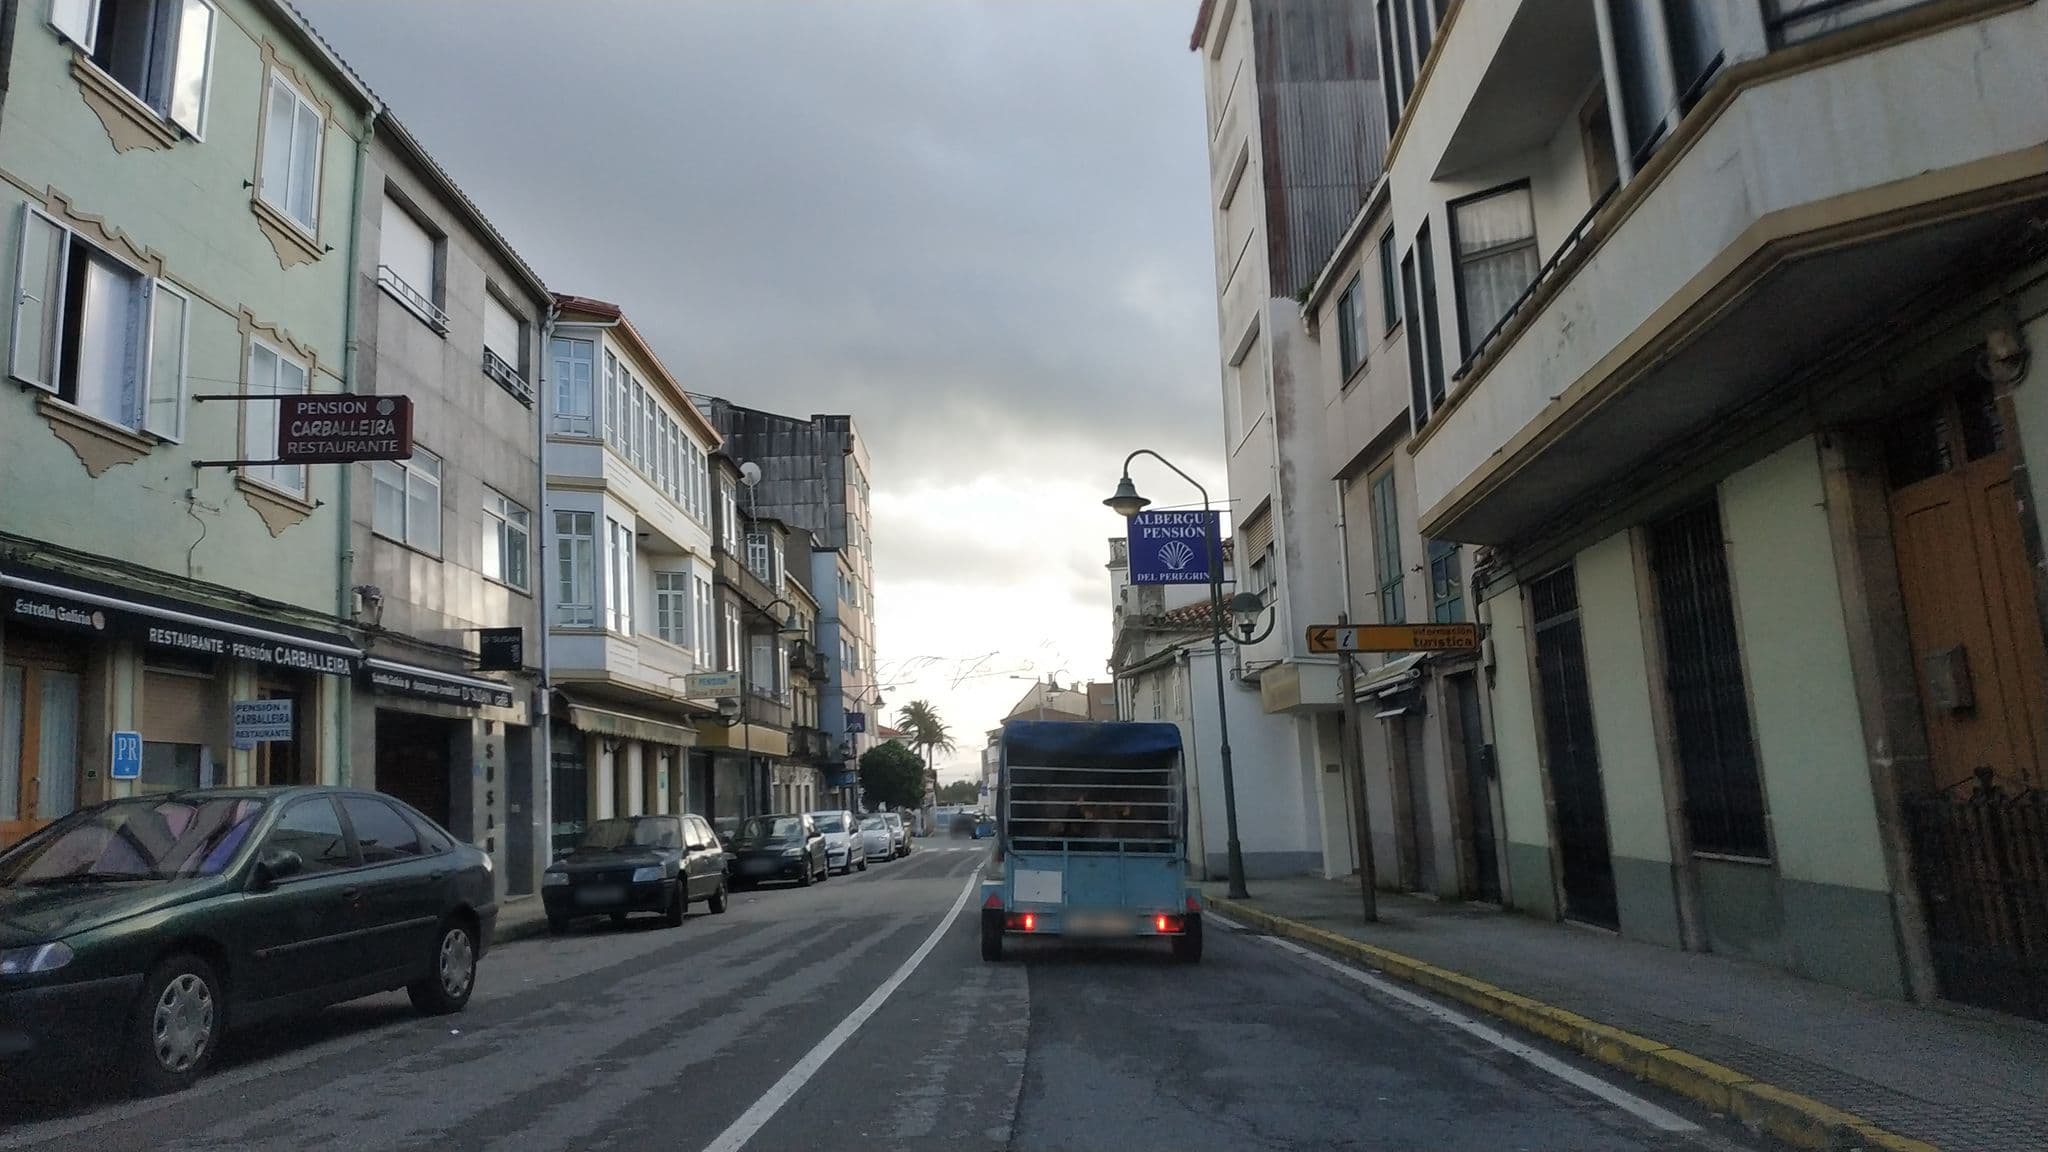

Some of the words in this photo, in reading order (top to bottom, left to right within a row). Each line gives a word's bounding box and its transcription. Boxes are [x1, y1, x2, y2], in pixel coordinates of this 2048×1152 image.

[297, 401, 367, 414] PENSION
[291, 419, 396, 437] CARBALLEIRA
[287, 440, 399, 454] RESTAURANTE
[1143, 524, 1206, 538] PENSIÓN
[1137, 573, 1157, 581] DEL
[1160, 571, 1210, 581] PEREGRIN
[14, 599, 56, 619] Estrella
[57, 606, 92, 625] Galicia
[149, 628, 224, 653] RESTAURANTE
[232, 643, 272, 662] PENSIÓN
[275, 647, 350, 675] CARBALLEIRA
[236, 704, 280, 712] PENSION
[236, 730, 290, 738] RESTAURANTE
[118, 737, 138, 760] PR
